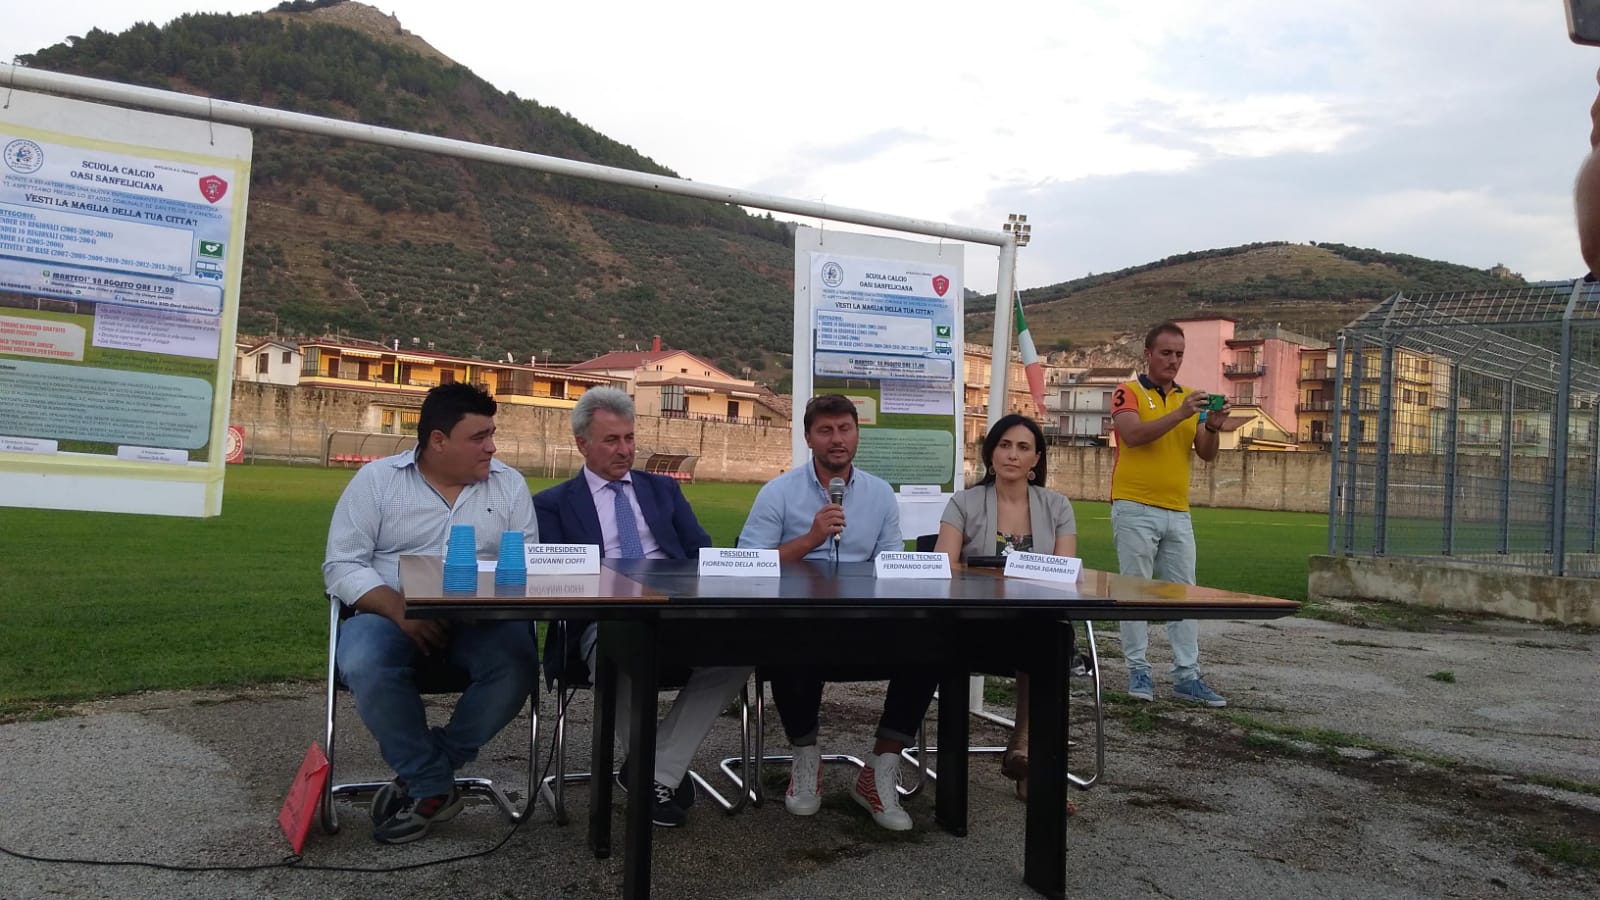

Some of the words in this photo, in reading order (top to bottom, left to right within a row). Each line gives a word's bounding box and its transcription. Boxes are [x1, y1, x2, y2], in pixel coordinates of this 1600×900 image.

[82, 161, 118, 173] SCUOLA
[122, 167, 155, 179] CALCIO
[70, 170, 93, 182] OASI
[96, 174, 164, 192] SANFELICIANA
[25, 193, 52, 204] VESTI
[56, 198, 68, 208] LA
[71, 200, 109, 214] MAGLIA
[112, 206, 142, 218] DELLA
[144, 212, 162, 222] TUA
[866, 272, 886, 280] SCUOLA
[888, 274, 907, 282] CALCIO
[104, 279, 134, 290] AGOSTO
[136, 283, 151, 291] ORE
[1114, 388, 1126, 407] 3
[720, 550, 760, 558] PRESIDENTE
[1020, 554, 1045, 563] MENTAL
[1046, 557, 1068, 565] COACH
[1042, 567, 1075, 575] SGAMBATO
